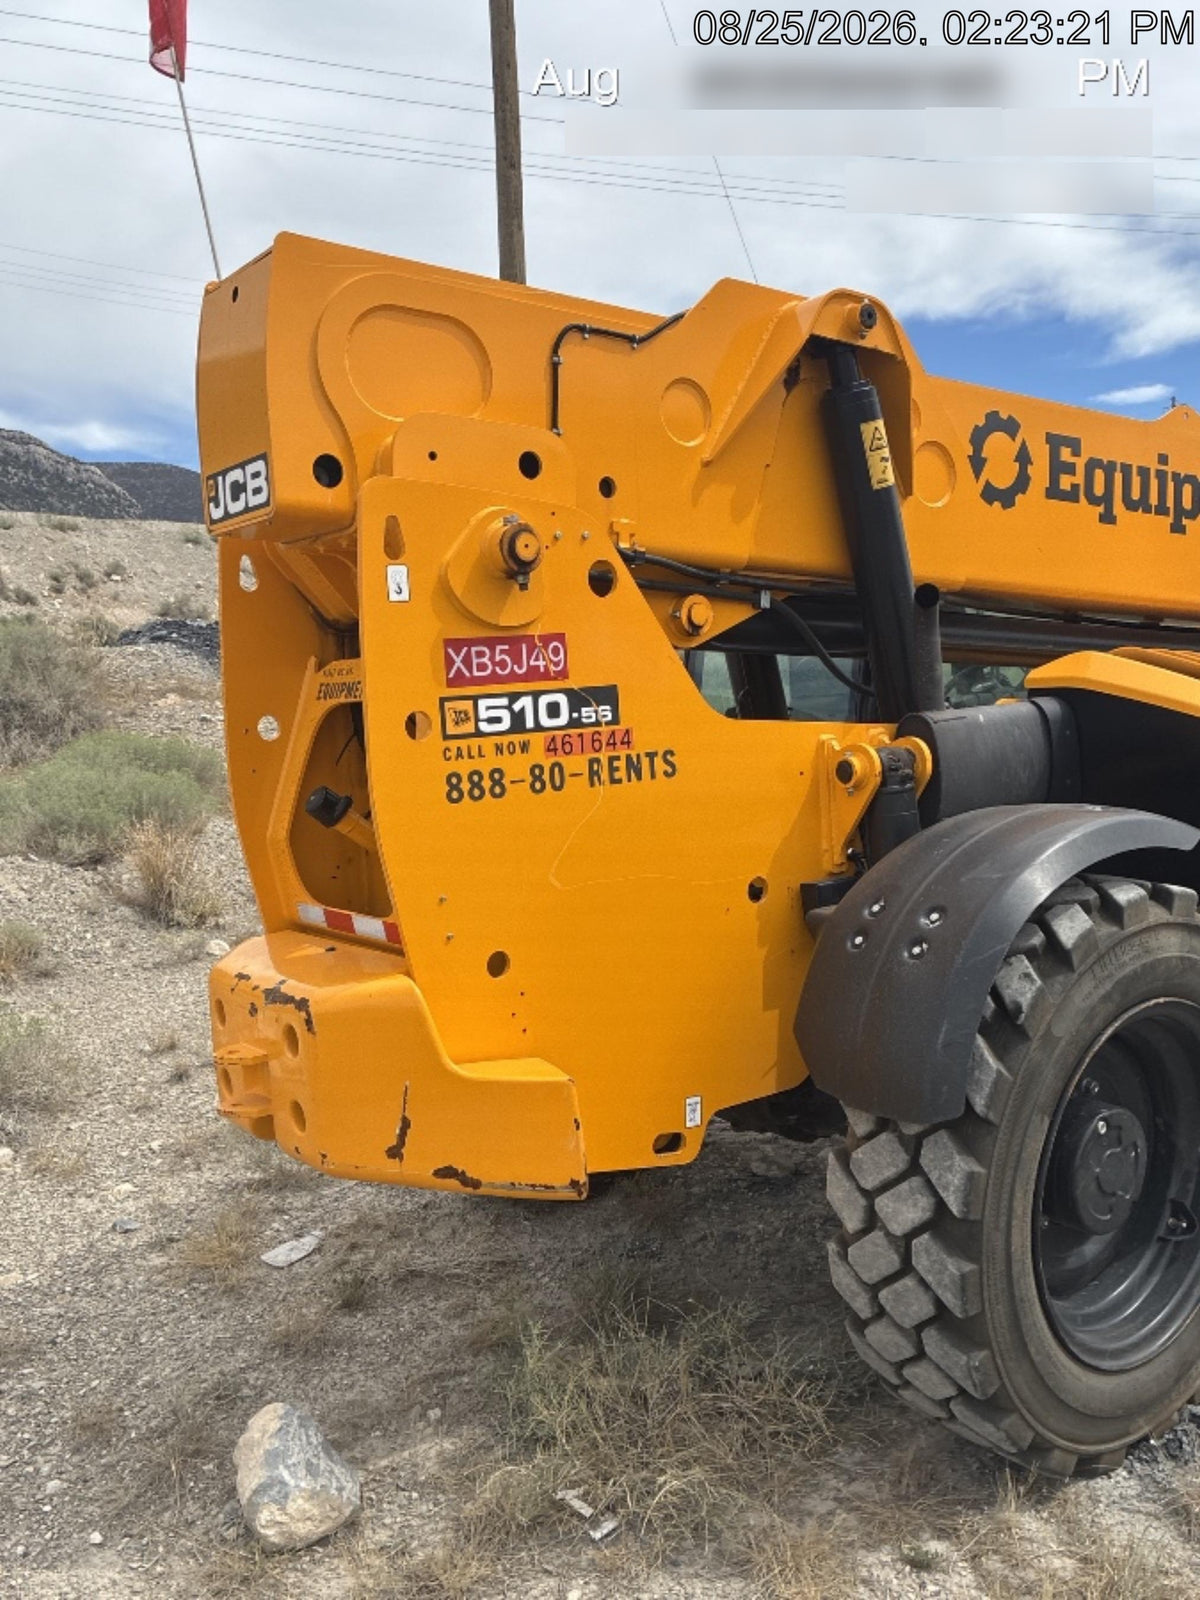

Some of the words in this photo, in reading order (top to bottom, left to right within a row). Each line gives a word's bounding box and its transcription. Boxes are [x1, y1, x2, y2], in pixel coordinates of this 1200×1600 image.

[209, 459, 269, 520] JCB
[447, 641, 565, 679] XB5J49
[443, 742, 486, 762] CALL
[494, 739, 532, 756] NOW
[545, 728, 633, 756] 461644
[445, 749, 678, 804] 888-80-RENTS
